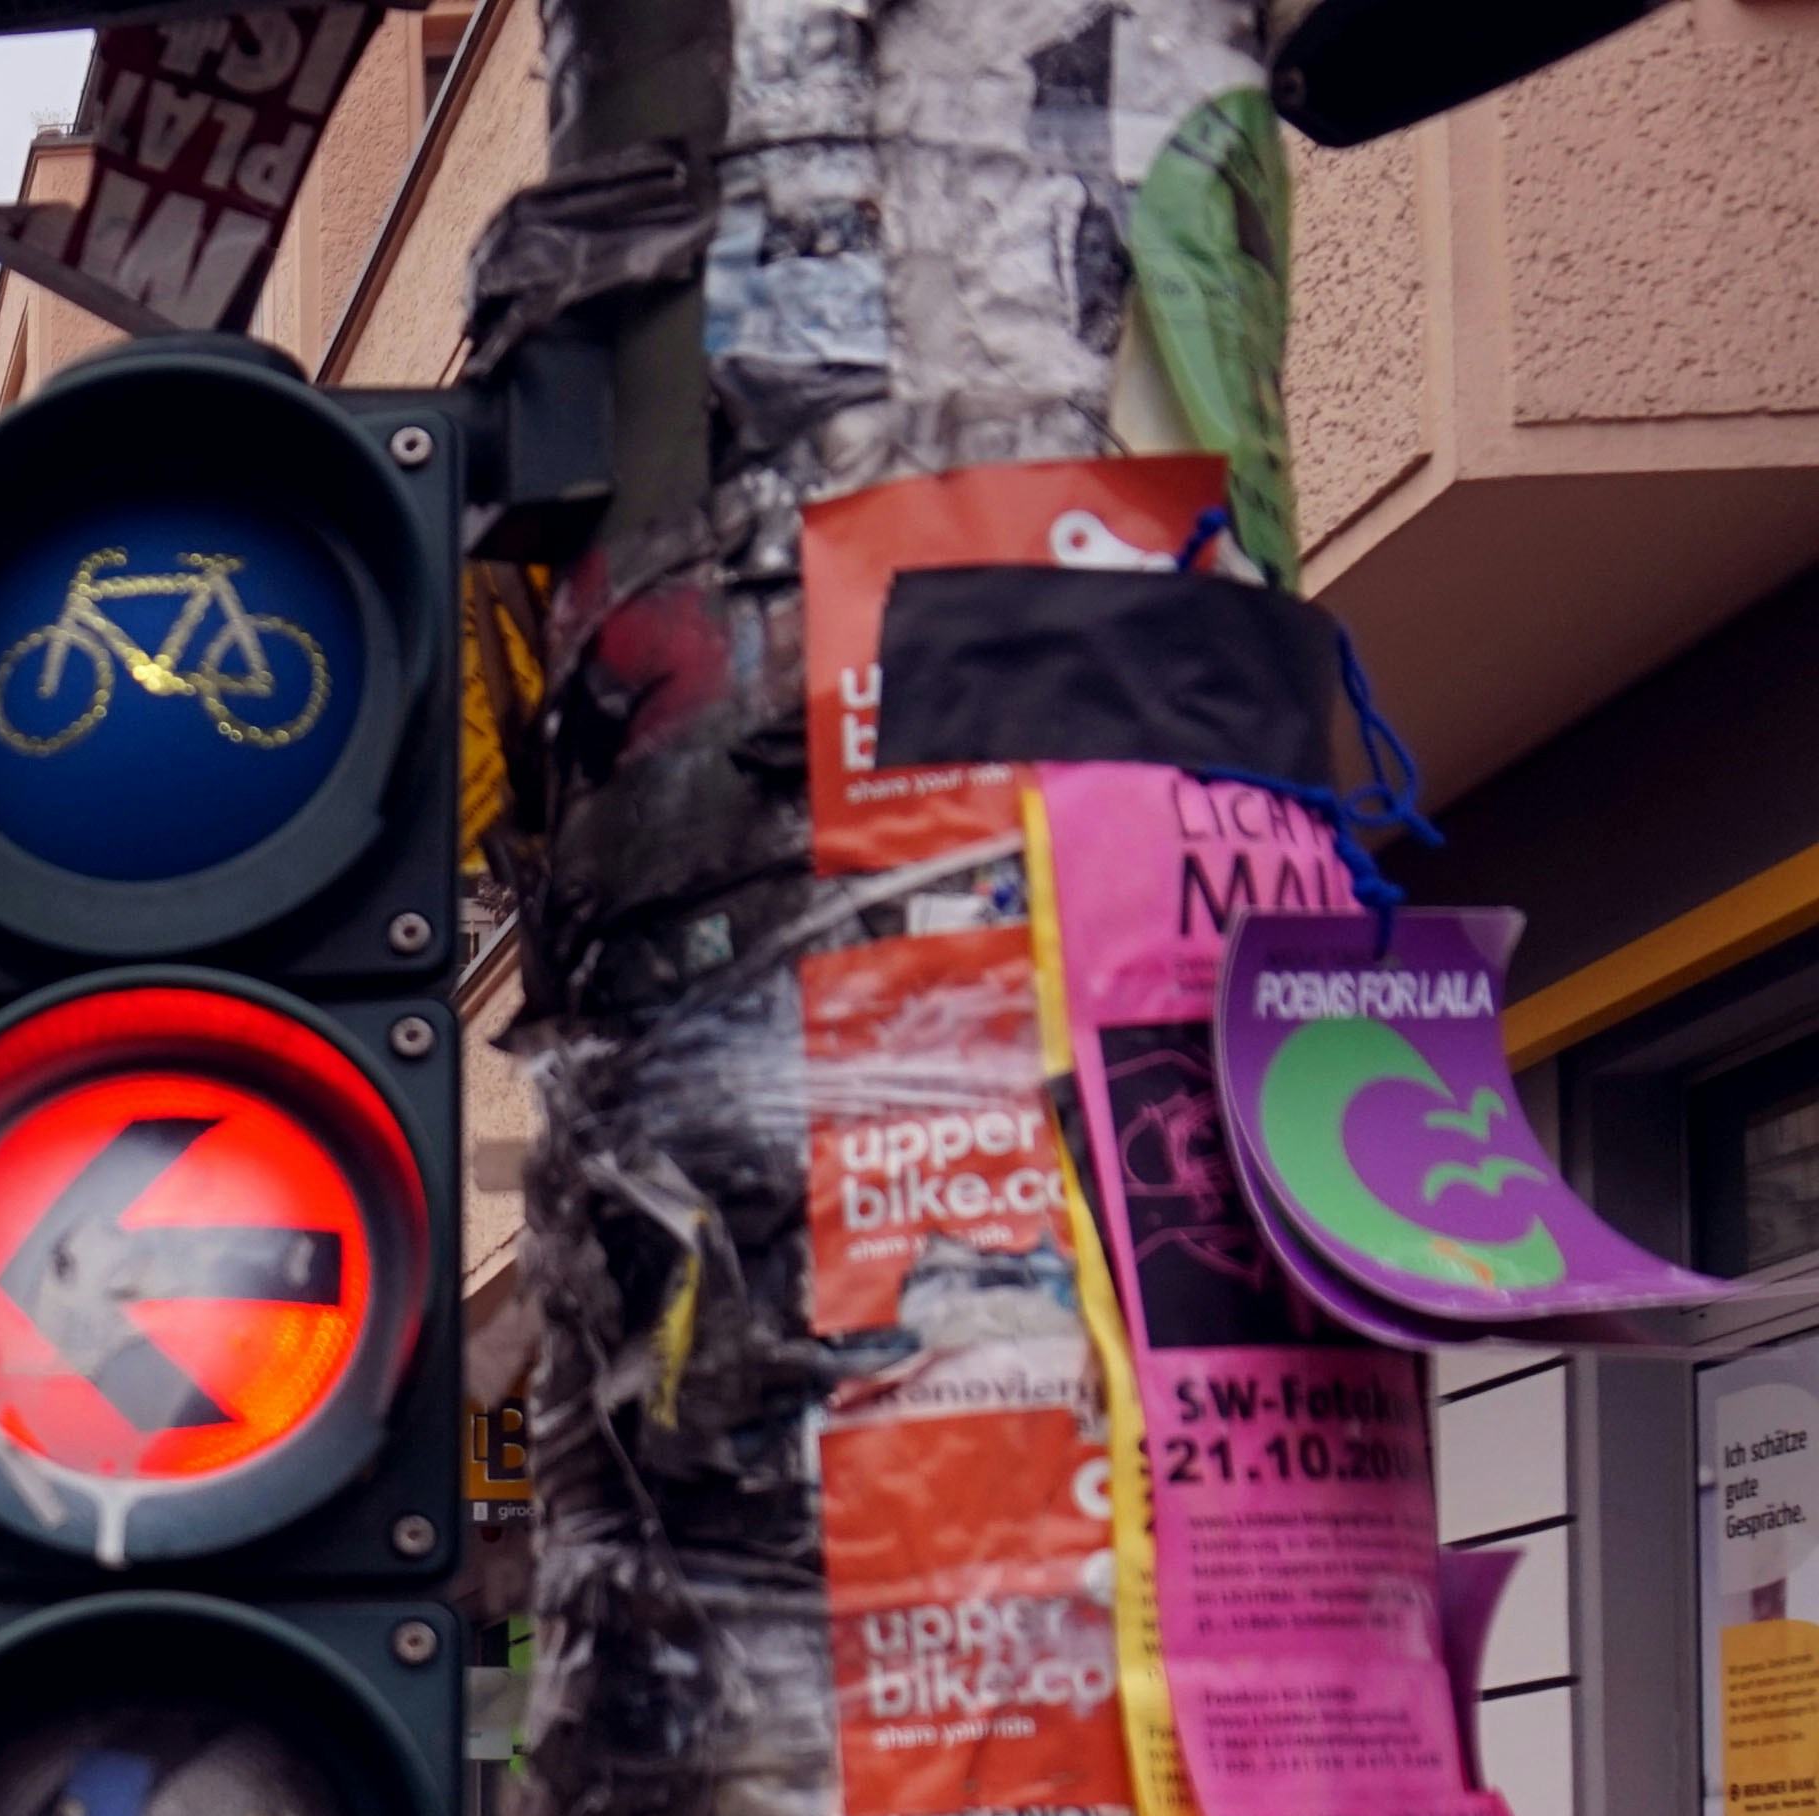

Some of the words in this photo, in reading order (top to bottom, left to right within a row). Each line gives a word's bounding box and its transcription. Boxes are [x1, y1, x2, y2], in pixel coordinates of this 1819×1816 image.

[1256, 969, 1357, 1019] POEMS
[1359, 969, 1419, 1017] FOR
[1420, 969, 1494, 1018] LAILA
[840, 1110, 1045, 1179] upper
[1725, 1442, 1745, 1468] Ich
[1751, 1429, 1807, 1462] schätze
[1726, 1476, 1758, 1509] gute
[1726, 1500, 1806, 1539] Gespräche.
